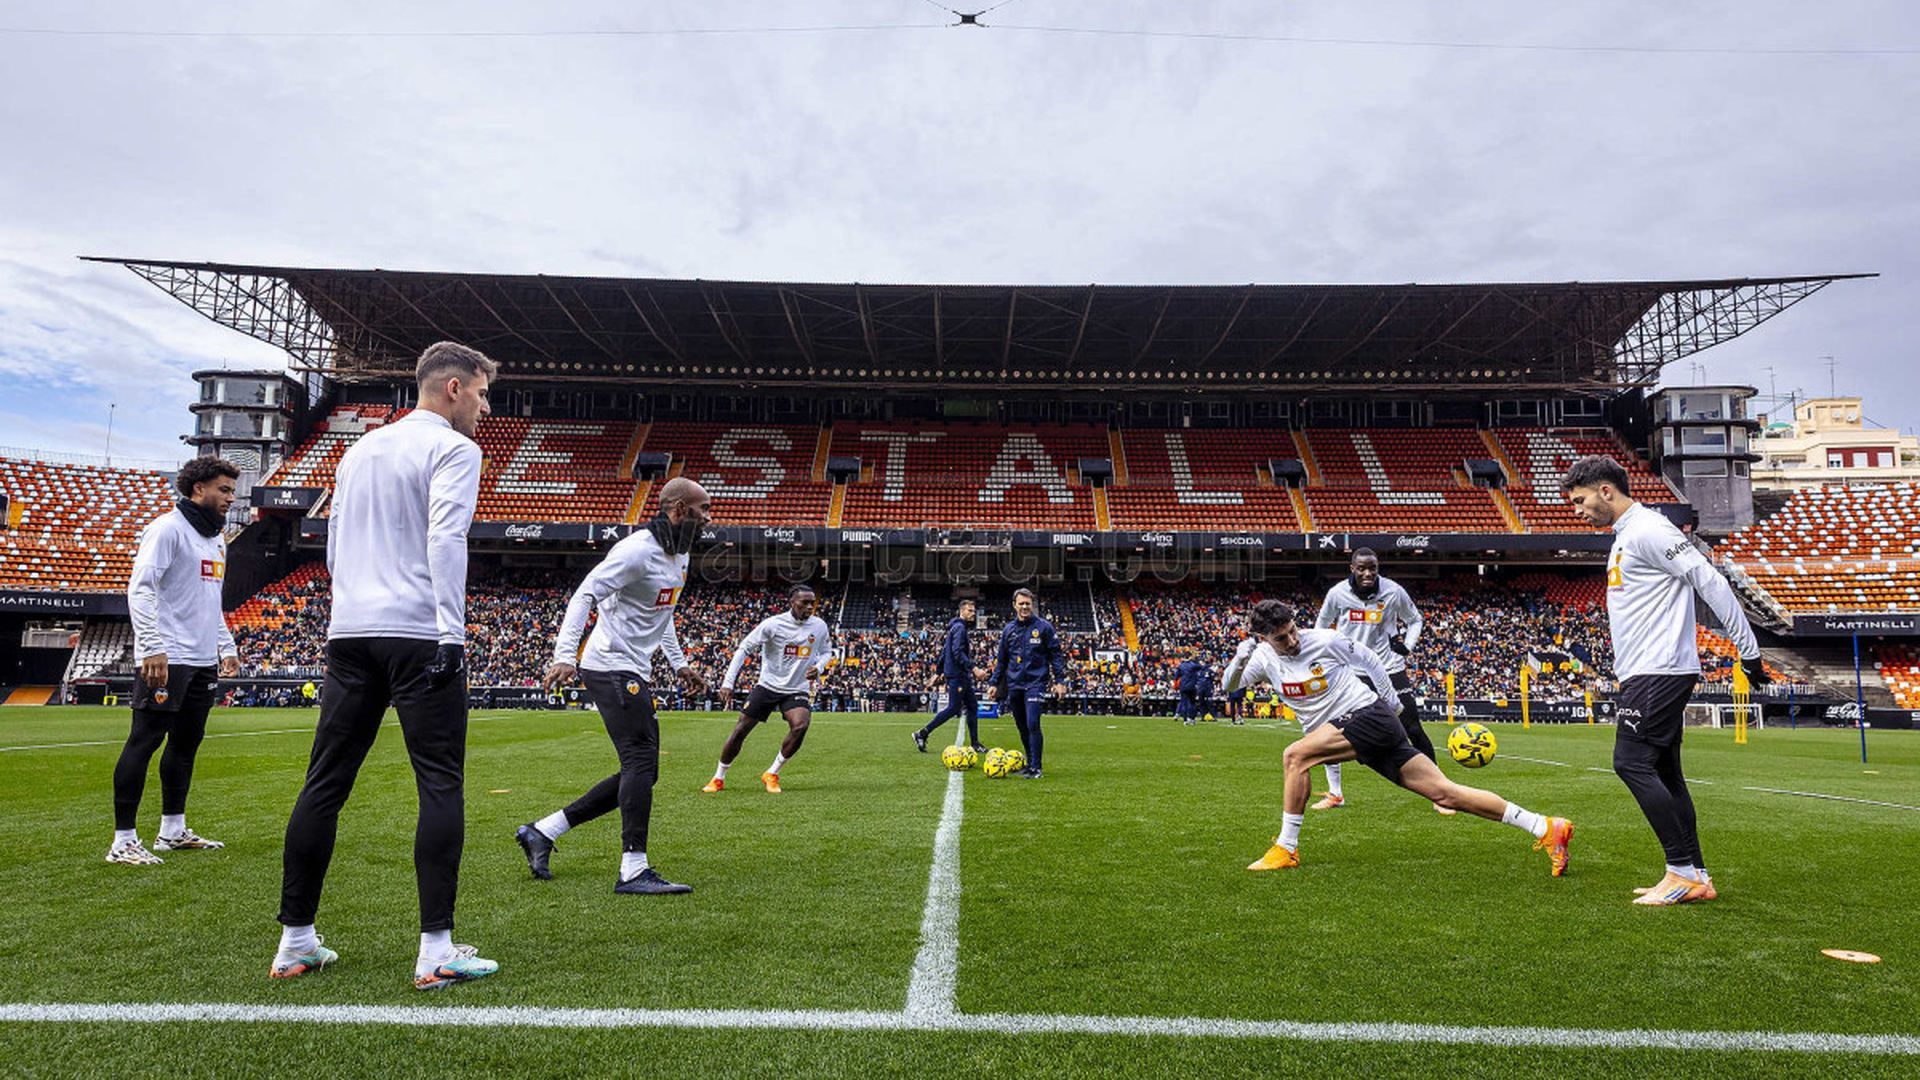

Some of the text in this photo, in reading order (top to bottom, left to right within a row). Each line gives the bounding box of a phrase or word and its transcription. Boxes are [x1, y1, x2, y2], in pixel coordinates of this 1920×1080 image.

[842, 531, 872, 541] PUMA
[1053, 534, 1084, 544] PUMA
[1825, 621, 1914, 629] MARTINELLI
